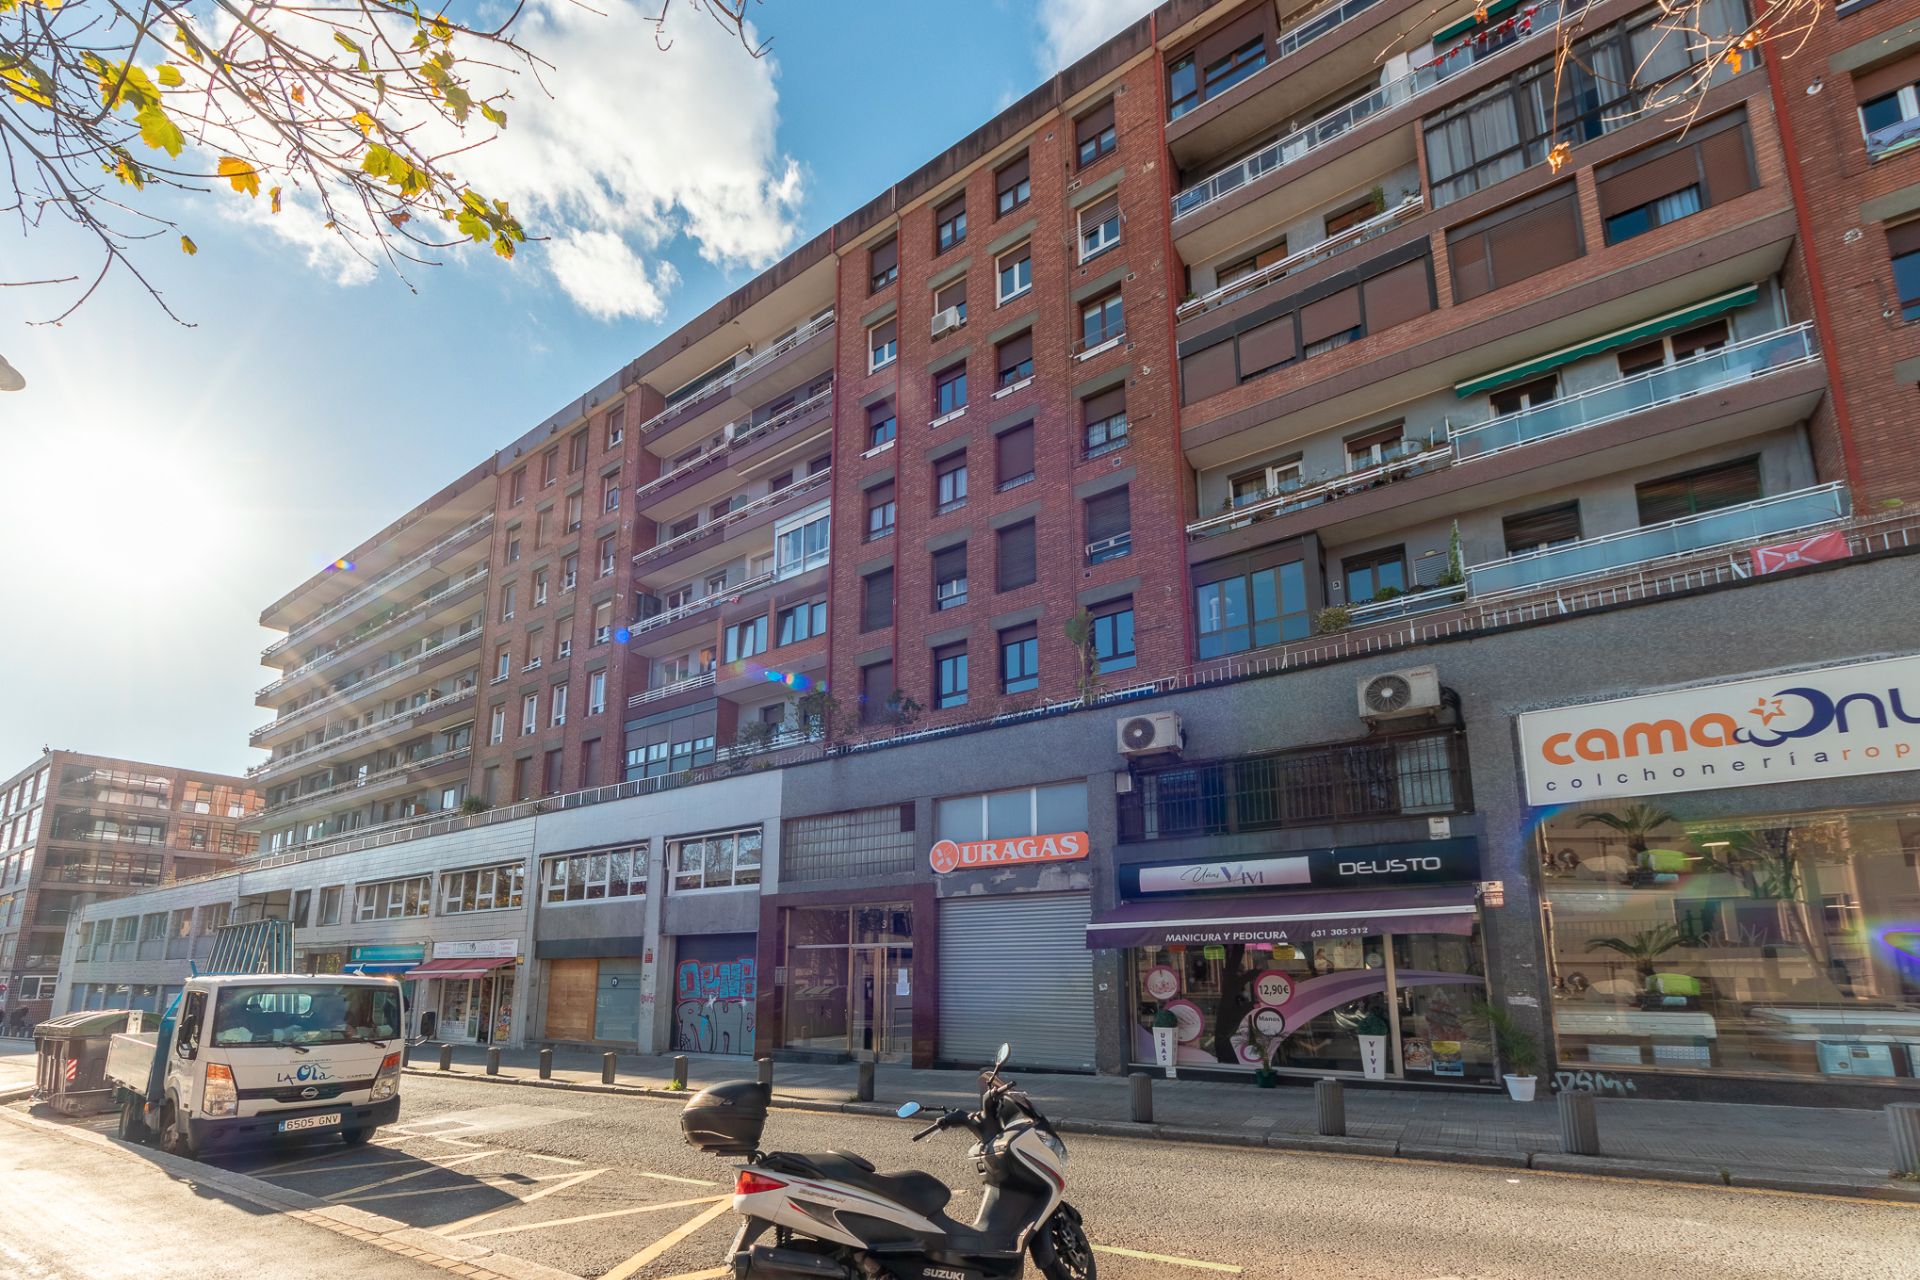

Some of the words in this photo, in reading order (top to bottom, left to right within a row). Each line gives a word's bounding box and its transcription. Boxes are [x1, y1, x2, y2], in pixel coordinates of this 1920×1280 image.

[961, 835, 1080, 864] URAGAS
[1338, 856, 1442, 876] DEUSTO
[1165, 932, 1222, 942] MANICURA
[1223, 932, 1230, 940] Y
[1232, 930, 1288, 941] PEDICURA
[1310, 929, 1326, 938] 631
[1330, 928, 1348, 936] 305
[1350, 926, 1369, 935] 312
[1258, 984, 1290, 996] 12,90€
[1159, 1032, 1167, 1062] UÑAS
[1368, 1040, 1377, 1074] VIVI
[277, 1072, 296, 1086] LA
[286, 1118, 314, 1130] 6505
[318, 1115, 339, 1125] GNV
[922, 1267, 966, 1280] SUZUKI
